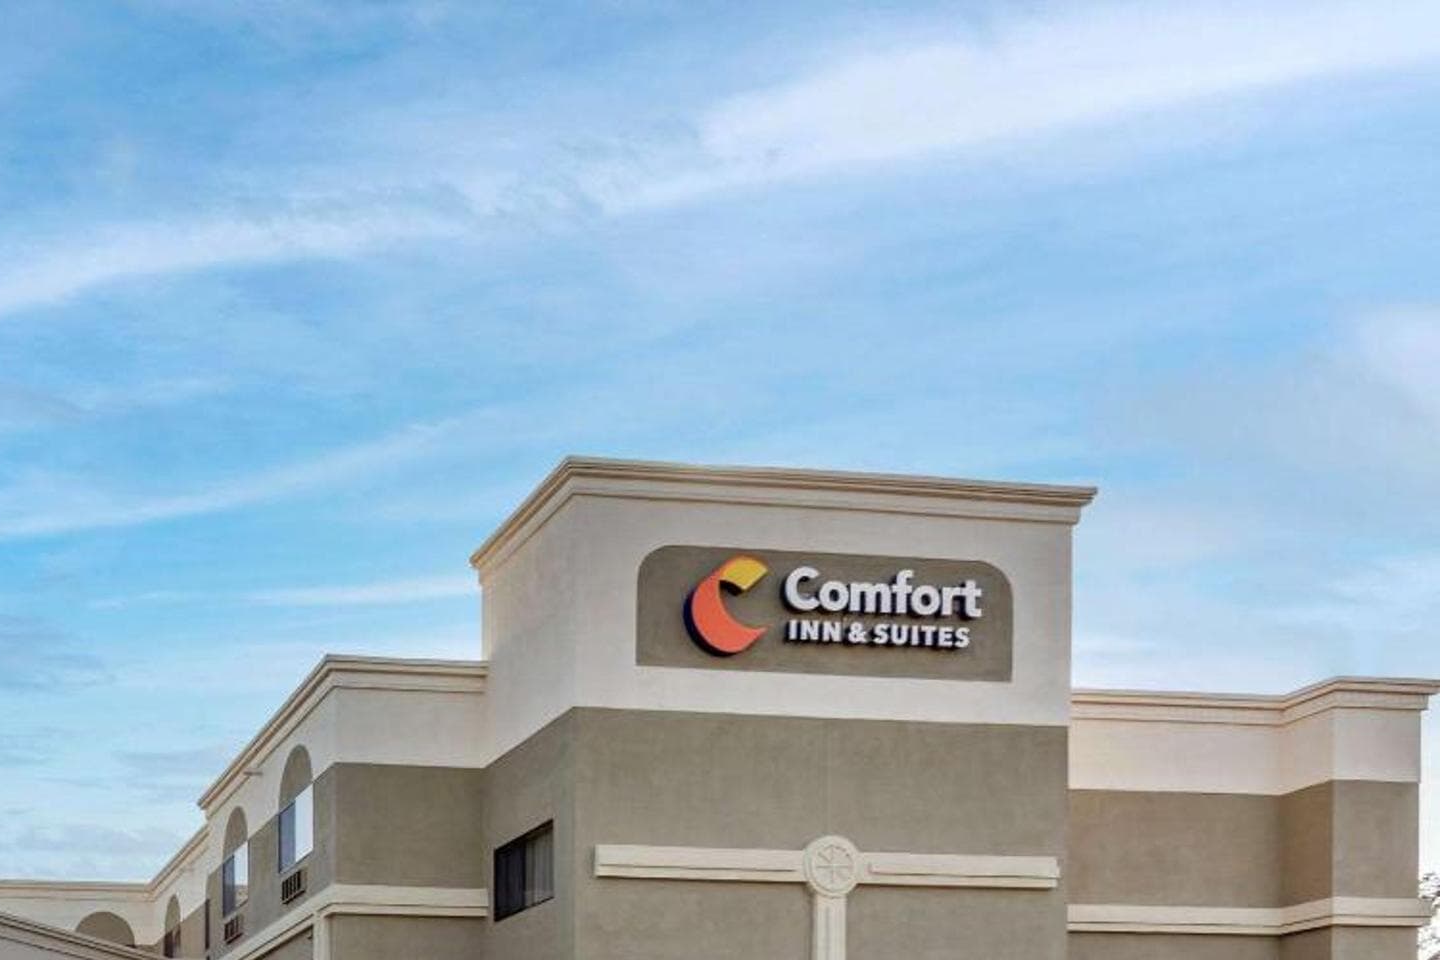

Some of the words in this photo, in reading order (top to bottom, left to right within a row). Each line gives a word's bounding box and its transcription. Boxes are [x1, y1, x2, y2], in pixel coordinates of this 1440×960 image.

[784, 566, 982, 617] Comfort
[789, 619, 841, 642] INN
[847, 621, 868, 644] &
[873, 623, 971, 647] SUITES
